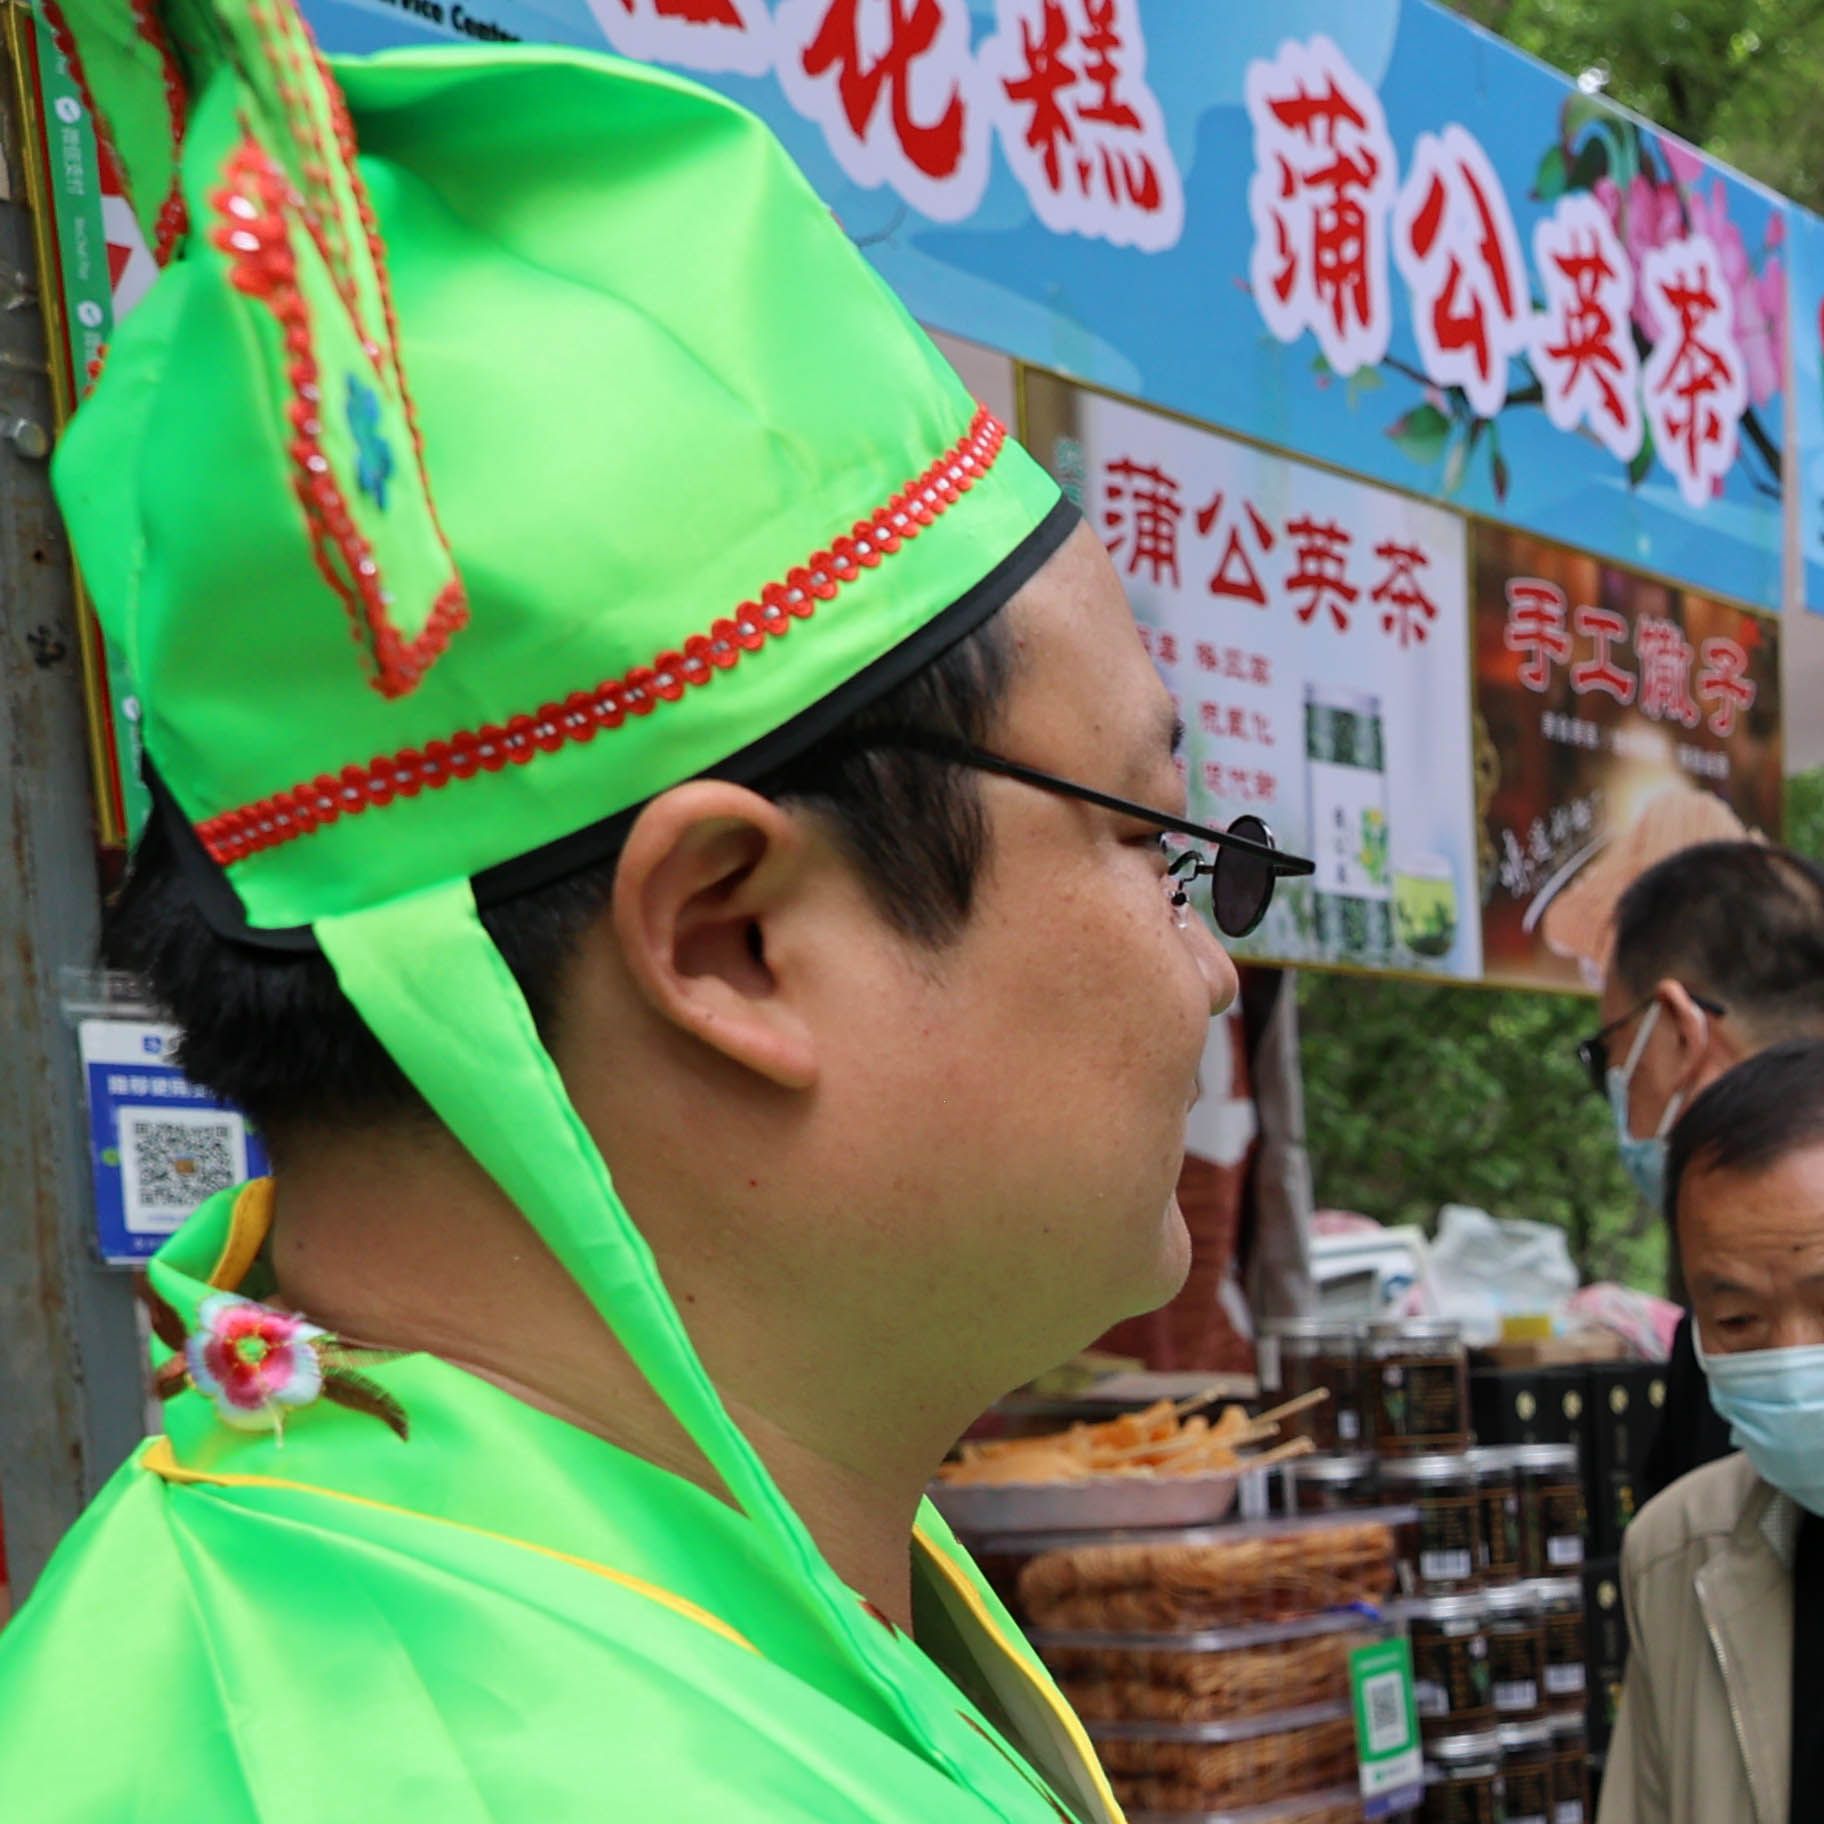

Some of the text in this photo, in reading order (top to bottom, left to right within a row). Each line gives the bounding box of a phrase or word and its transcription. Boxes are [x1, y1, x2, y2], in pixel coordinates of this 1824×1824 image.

[617, 0, 1732, 478] 花糕 蒲公英茶
[1104, 455, 1440, 650] 蒲公英茶
